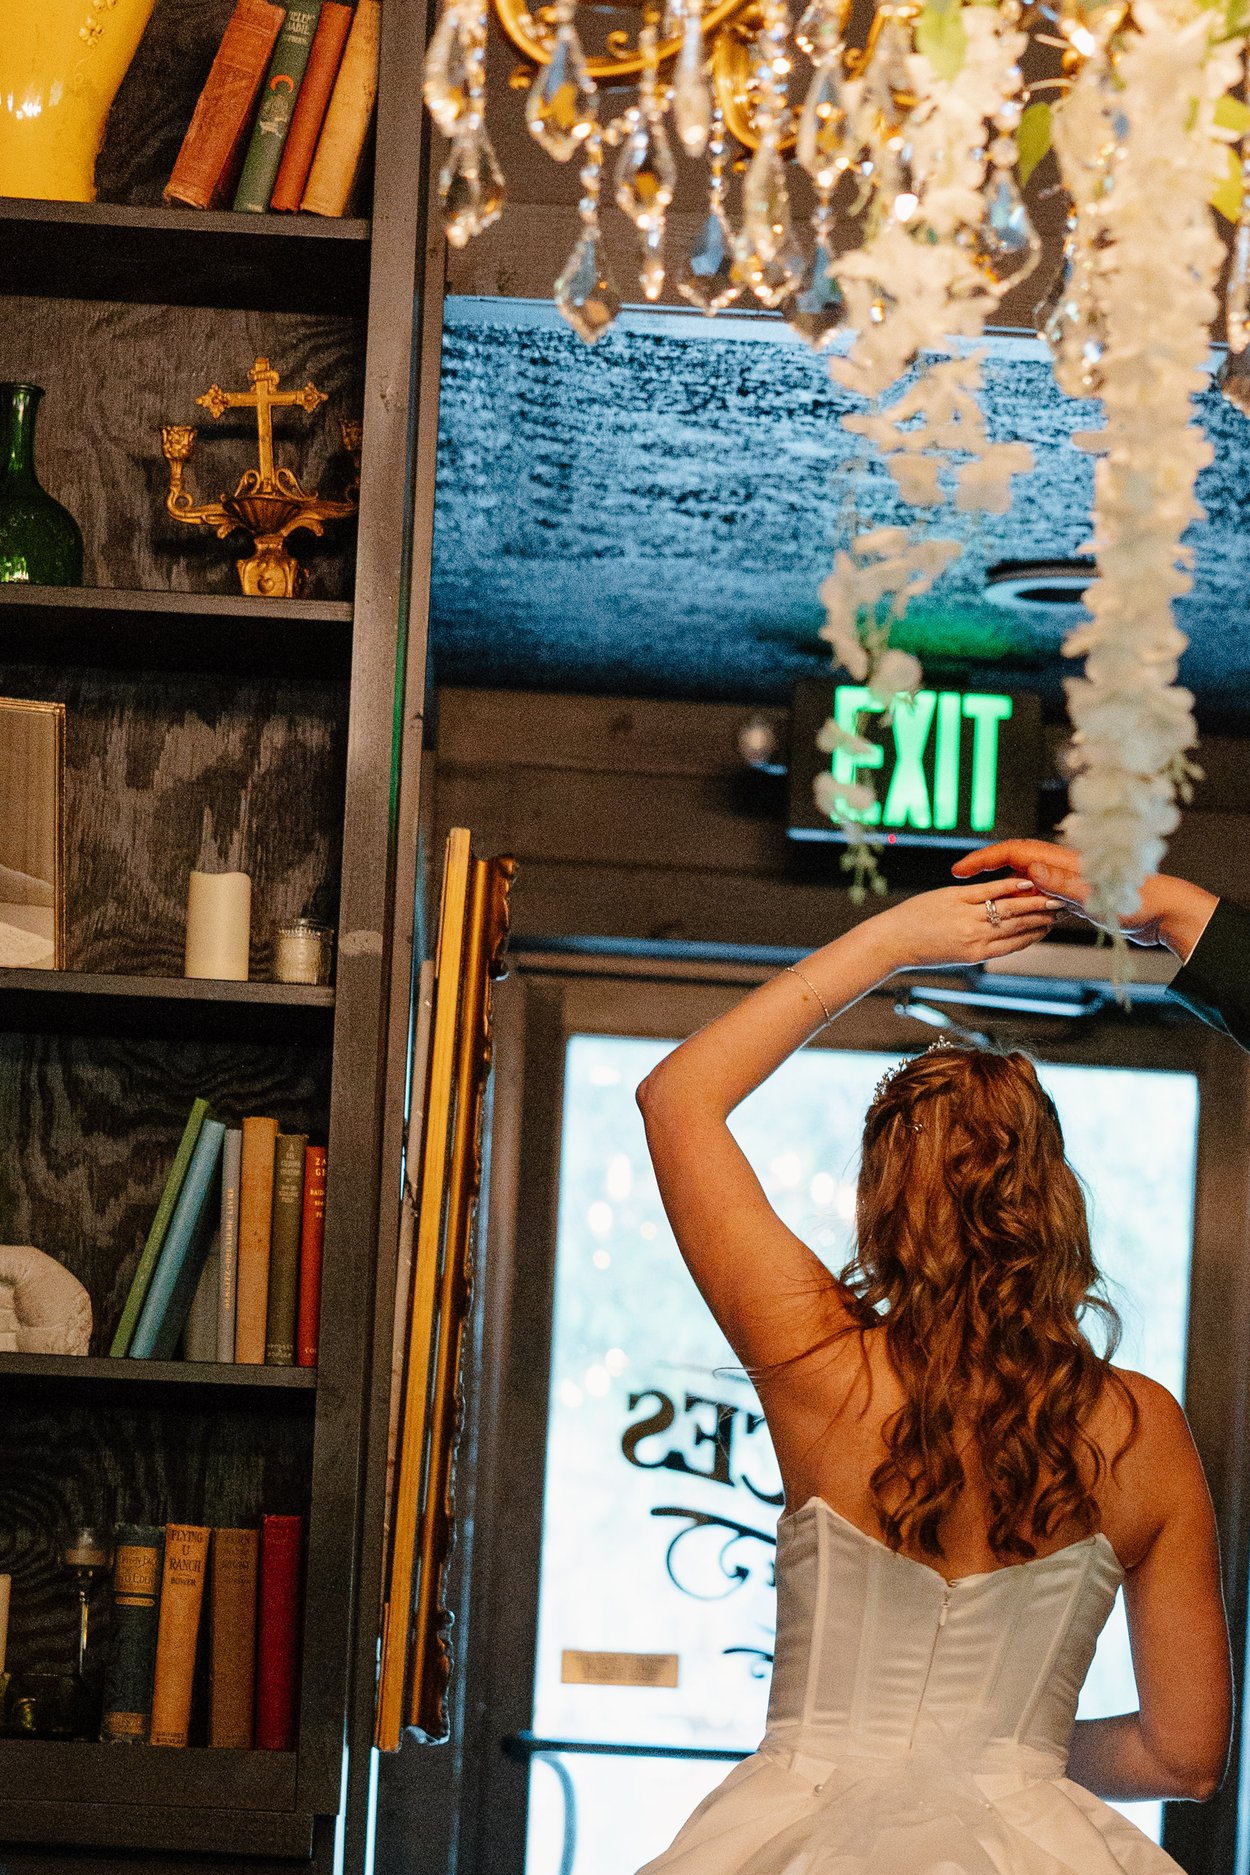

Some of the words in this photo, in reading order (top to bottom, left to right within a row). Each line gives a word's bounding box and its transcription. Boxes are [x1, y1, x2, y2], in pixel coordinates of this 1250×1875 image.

[831, 685, 1013, 832] EXIT
[171, 1529, 203, 1543] FLYING
[182, 1544, 190, 1556] U
[169, 1557, 201, 1573] RANCH
